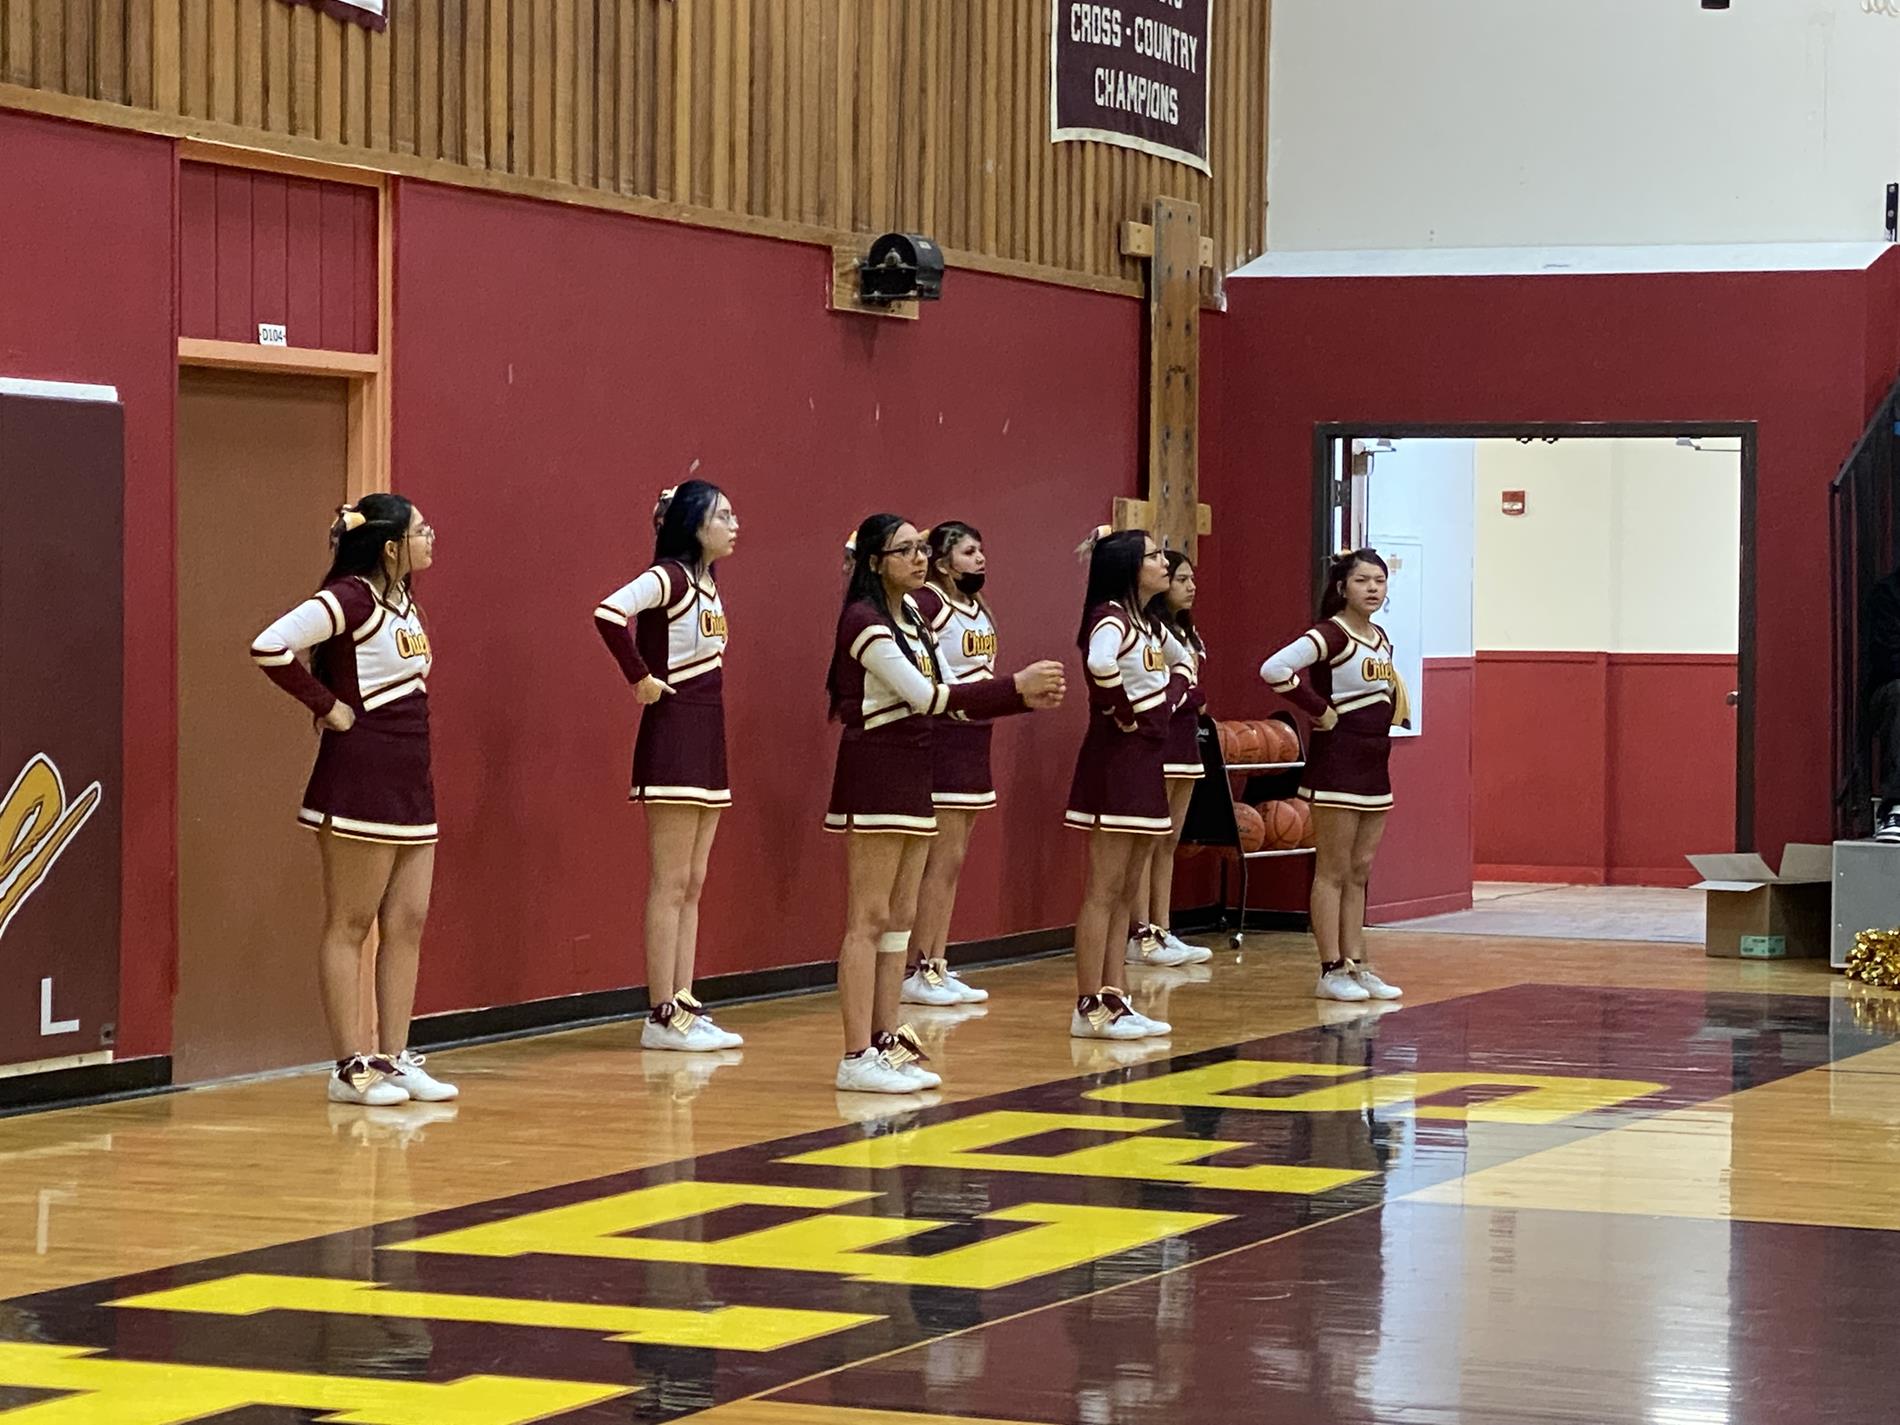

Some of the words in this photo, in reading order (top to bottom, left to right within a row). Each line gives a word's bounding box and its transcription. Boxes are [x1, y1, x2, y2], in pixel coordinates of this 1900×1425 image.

[1071, 3, 1121, 47] CROSS
[1135, 16, 1197, 73] COUNTRY
[1095, 67, 1178, 125] CHAMPIONS
[262, 328, 283, 342] D104
[40, 977, 80, 1036] L
